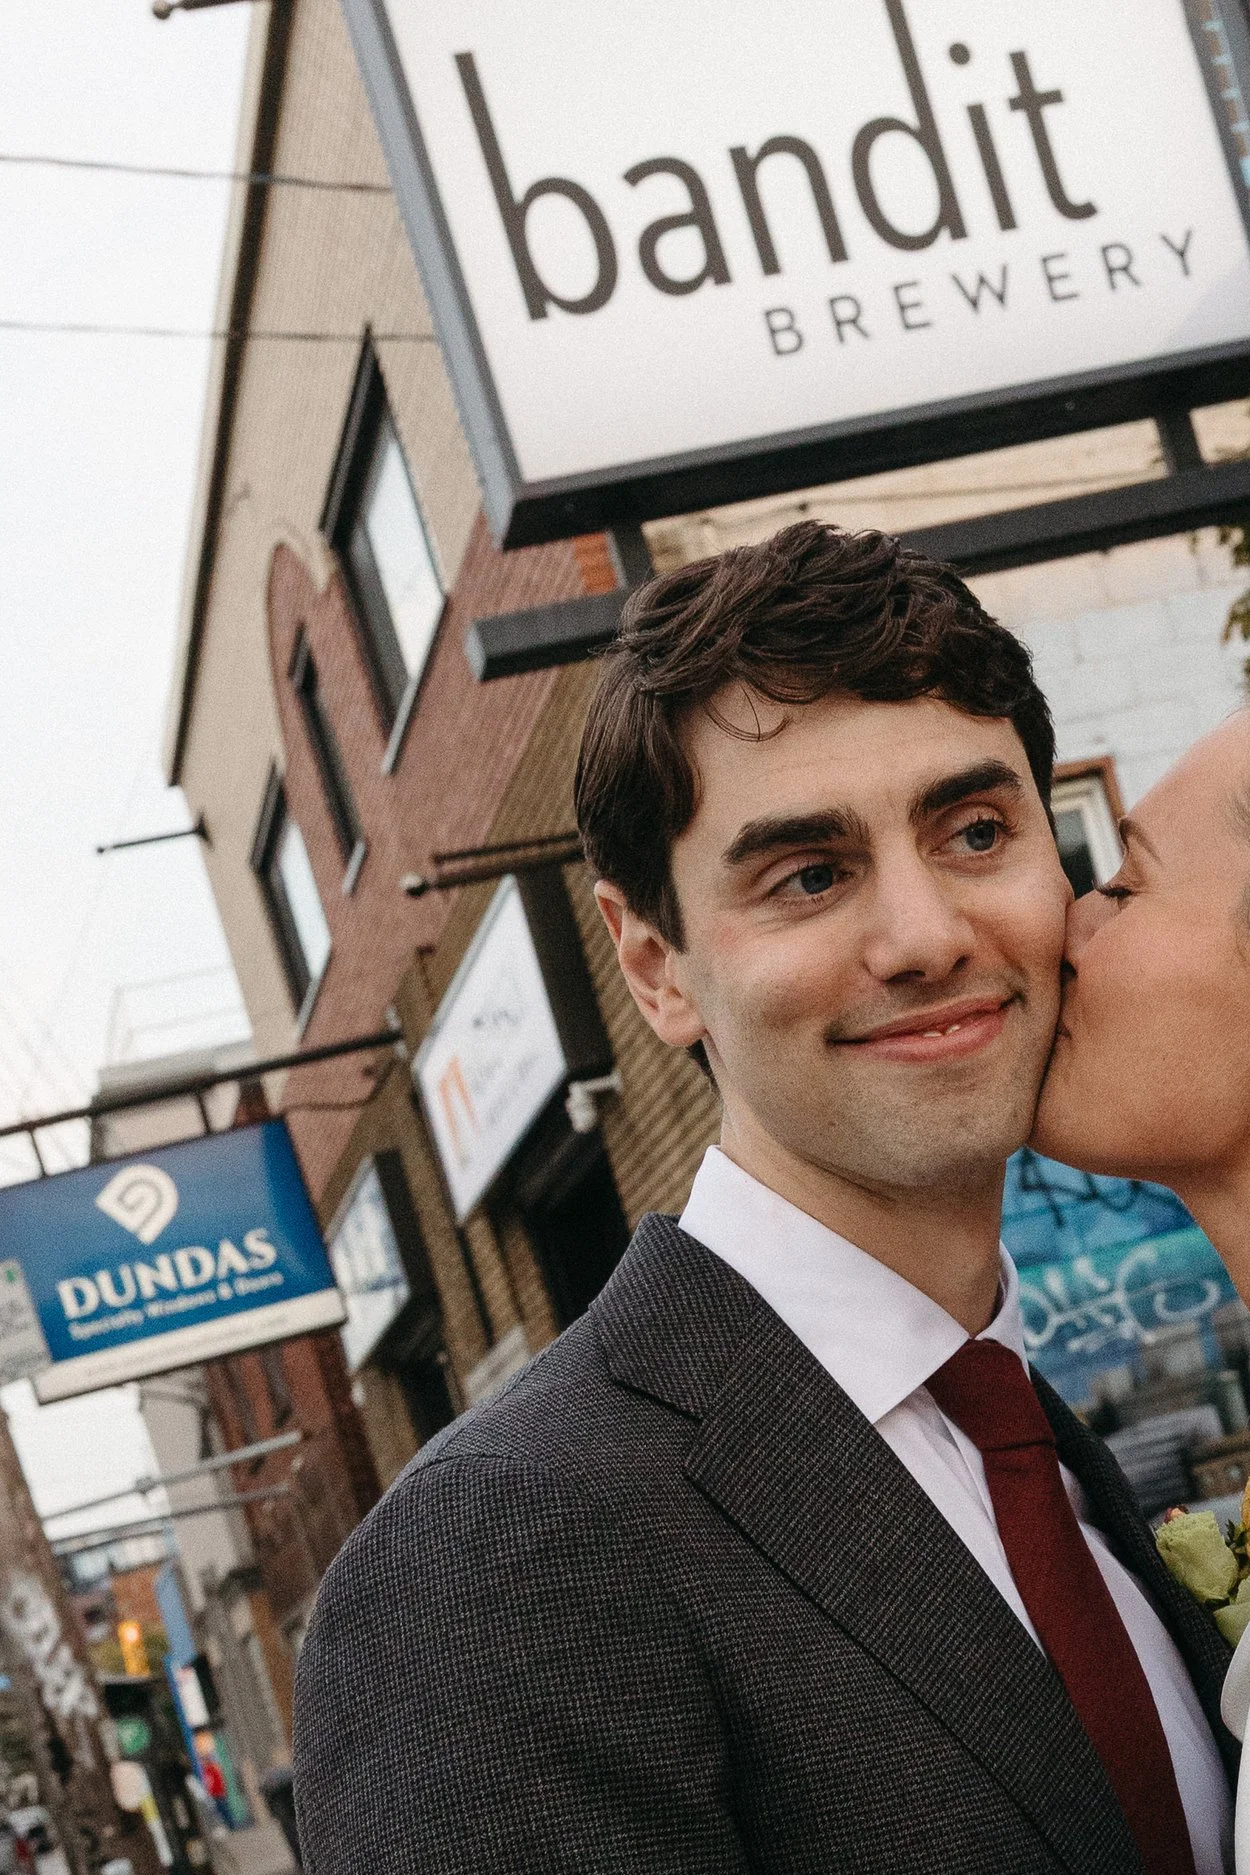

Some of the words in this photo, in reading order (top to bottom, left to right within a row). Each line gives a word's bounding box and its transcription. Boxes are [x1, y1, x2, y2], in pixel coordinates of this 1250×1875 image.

[455, 0, 1098, 320] bandit
[764, 230, 1196, 357] BREWERY
[58, 1228, 277, 1319] DUNDAS
